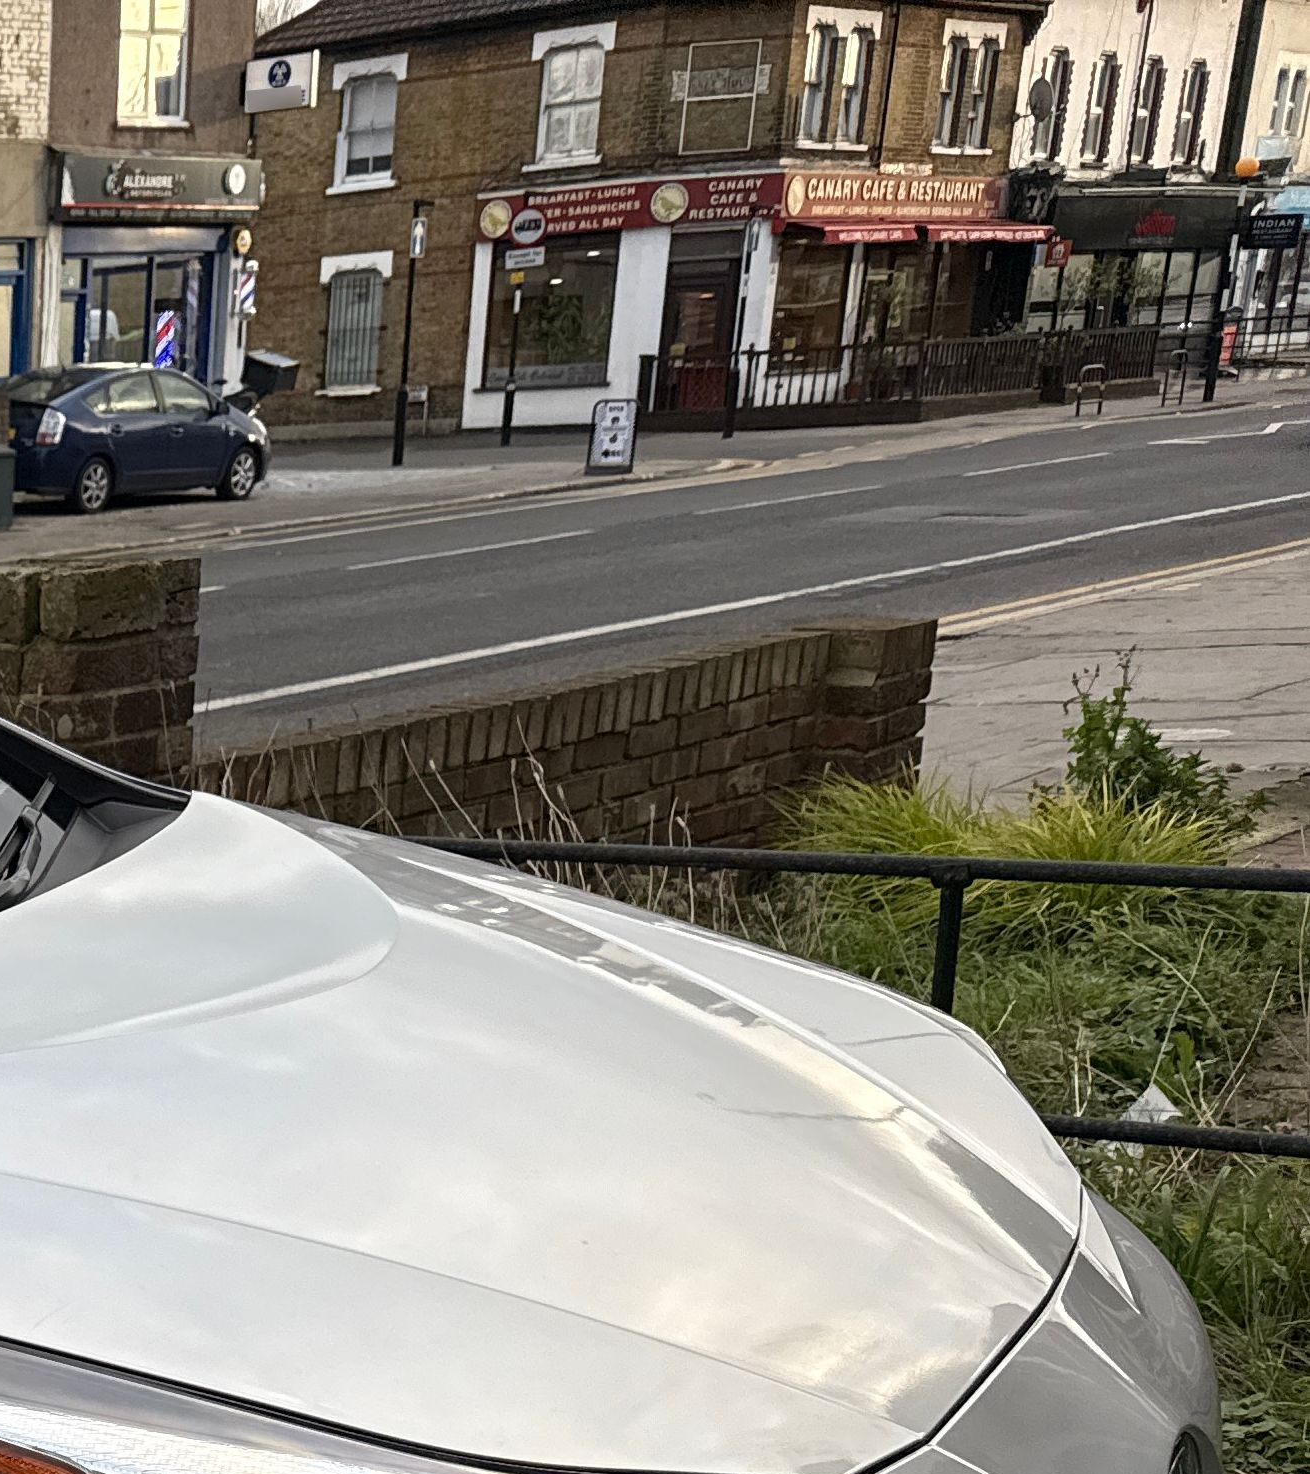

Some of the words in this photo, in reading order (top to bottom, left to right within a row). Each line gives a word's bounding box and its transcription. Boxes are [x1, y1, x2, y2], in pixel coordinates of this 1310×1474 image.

[123, 174, 173, 189] ALEXANDRE
[708, 178, 764, 192] CANARY
[807, 177, 861, 200] CANARY
[862, 179, 895, 201] CAFE
[896, 181, 907, 201] &
[909, 181, 985, 201] RESTAURANT
[597, 185, 637, 199] LUNCH
[710, 192, 745, 206] CAFE
[748, 191, 758, 204] &
[567, 199, 641, 217] SANDWICHES
[578, 218, 600, 230] ALL
[602, 215, 625, 228] DAY
[1252, 216, 1297, 229] INDIAN
